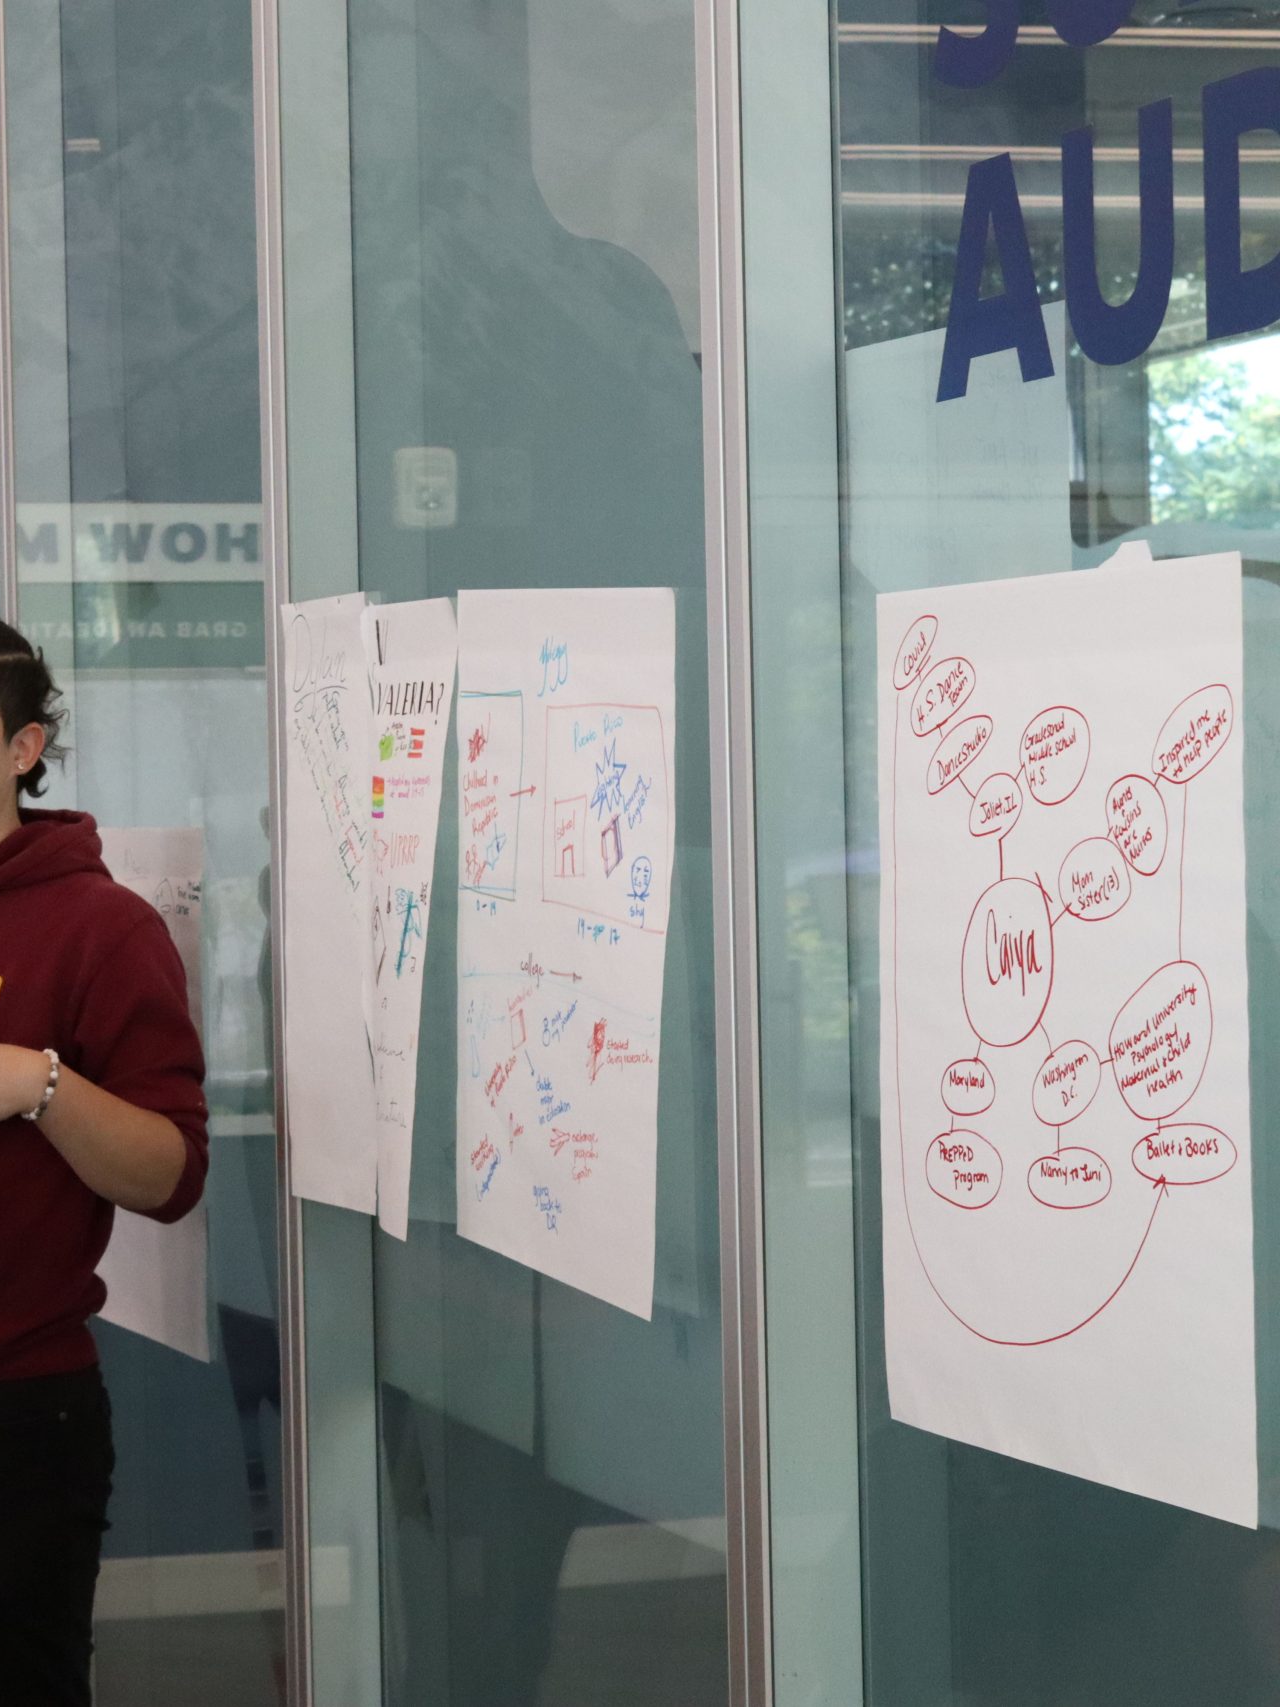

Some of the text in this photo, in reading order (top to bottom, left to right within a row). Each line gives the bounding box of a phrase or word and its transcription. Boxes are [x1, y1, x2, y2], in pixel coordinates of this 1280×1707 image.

[1071, 871, 1094, 893] Mom
[985, 908, 1043, 997] Caiya
[949, 1069, 985, 1093] Maryland
[1042, 1053, 1089, 1089] Washington
[1144, 1137, 1175, 1160] Ballet
